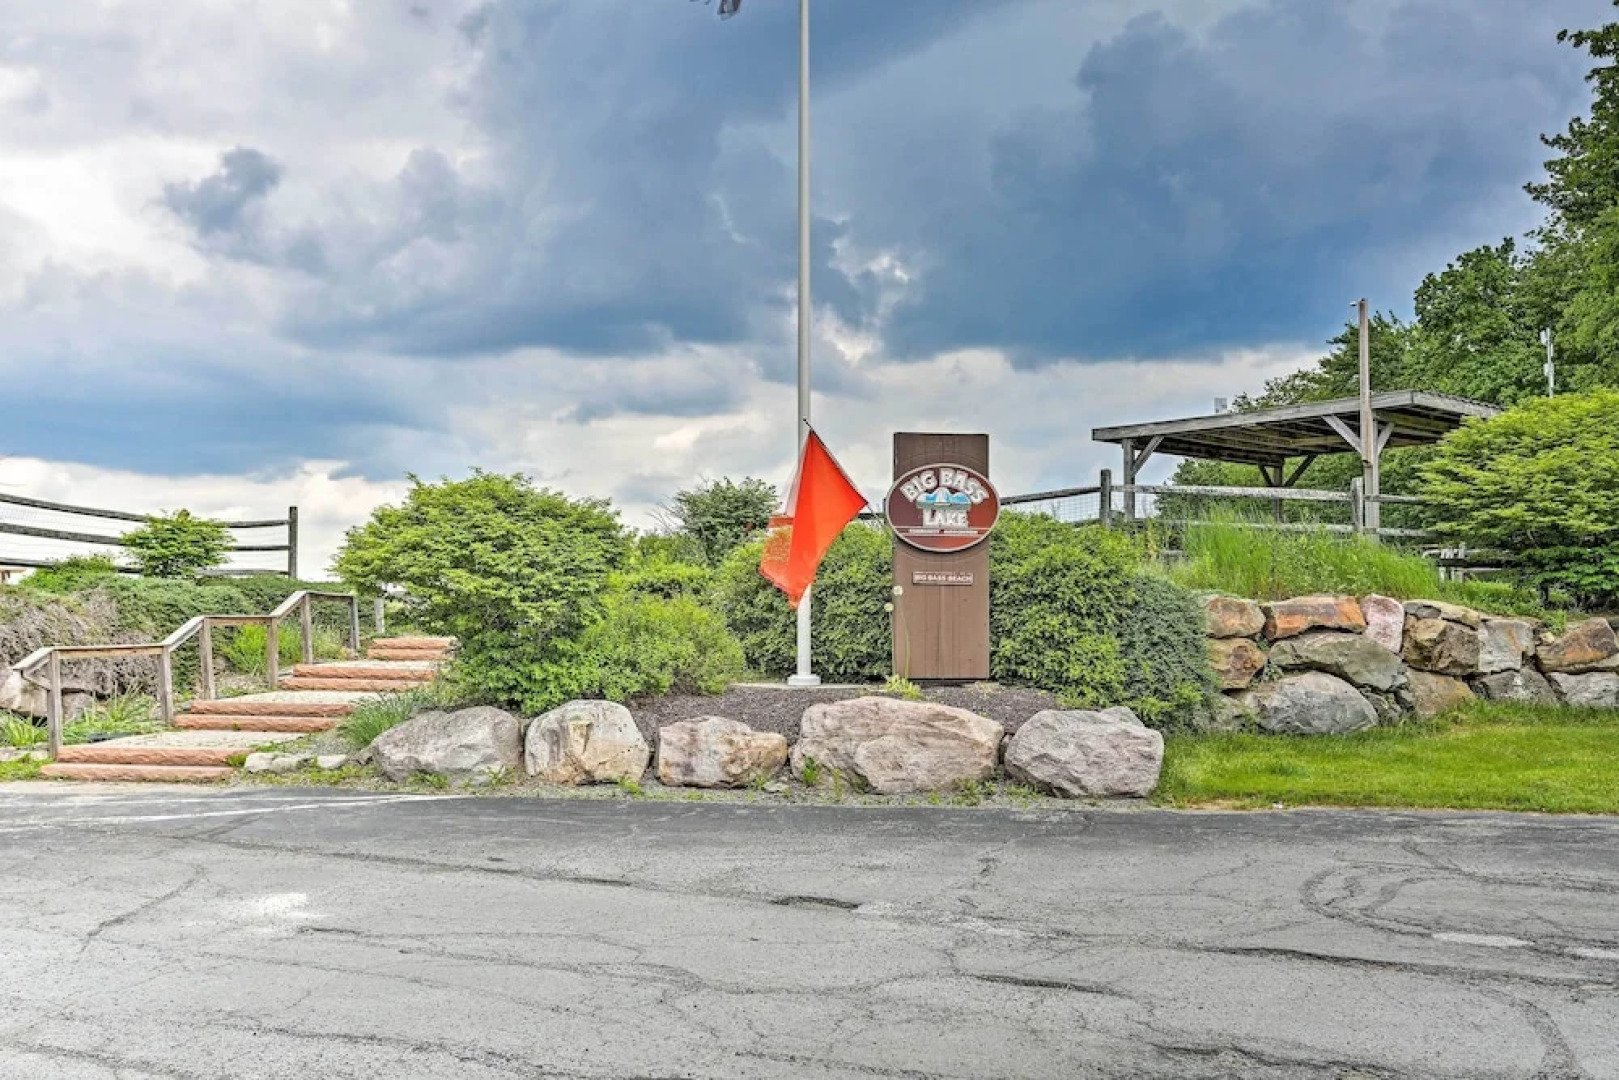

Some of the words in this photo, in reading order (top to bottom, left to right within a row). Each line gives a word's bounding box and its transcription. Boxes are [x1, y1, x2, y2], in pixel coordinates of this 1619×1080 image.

[900, 470, 937, 502] BIG
[940, 468, 989, 504] BASS
[923, 509, 968, 528] LAKE
